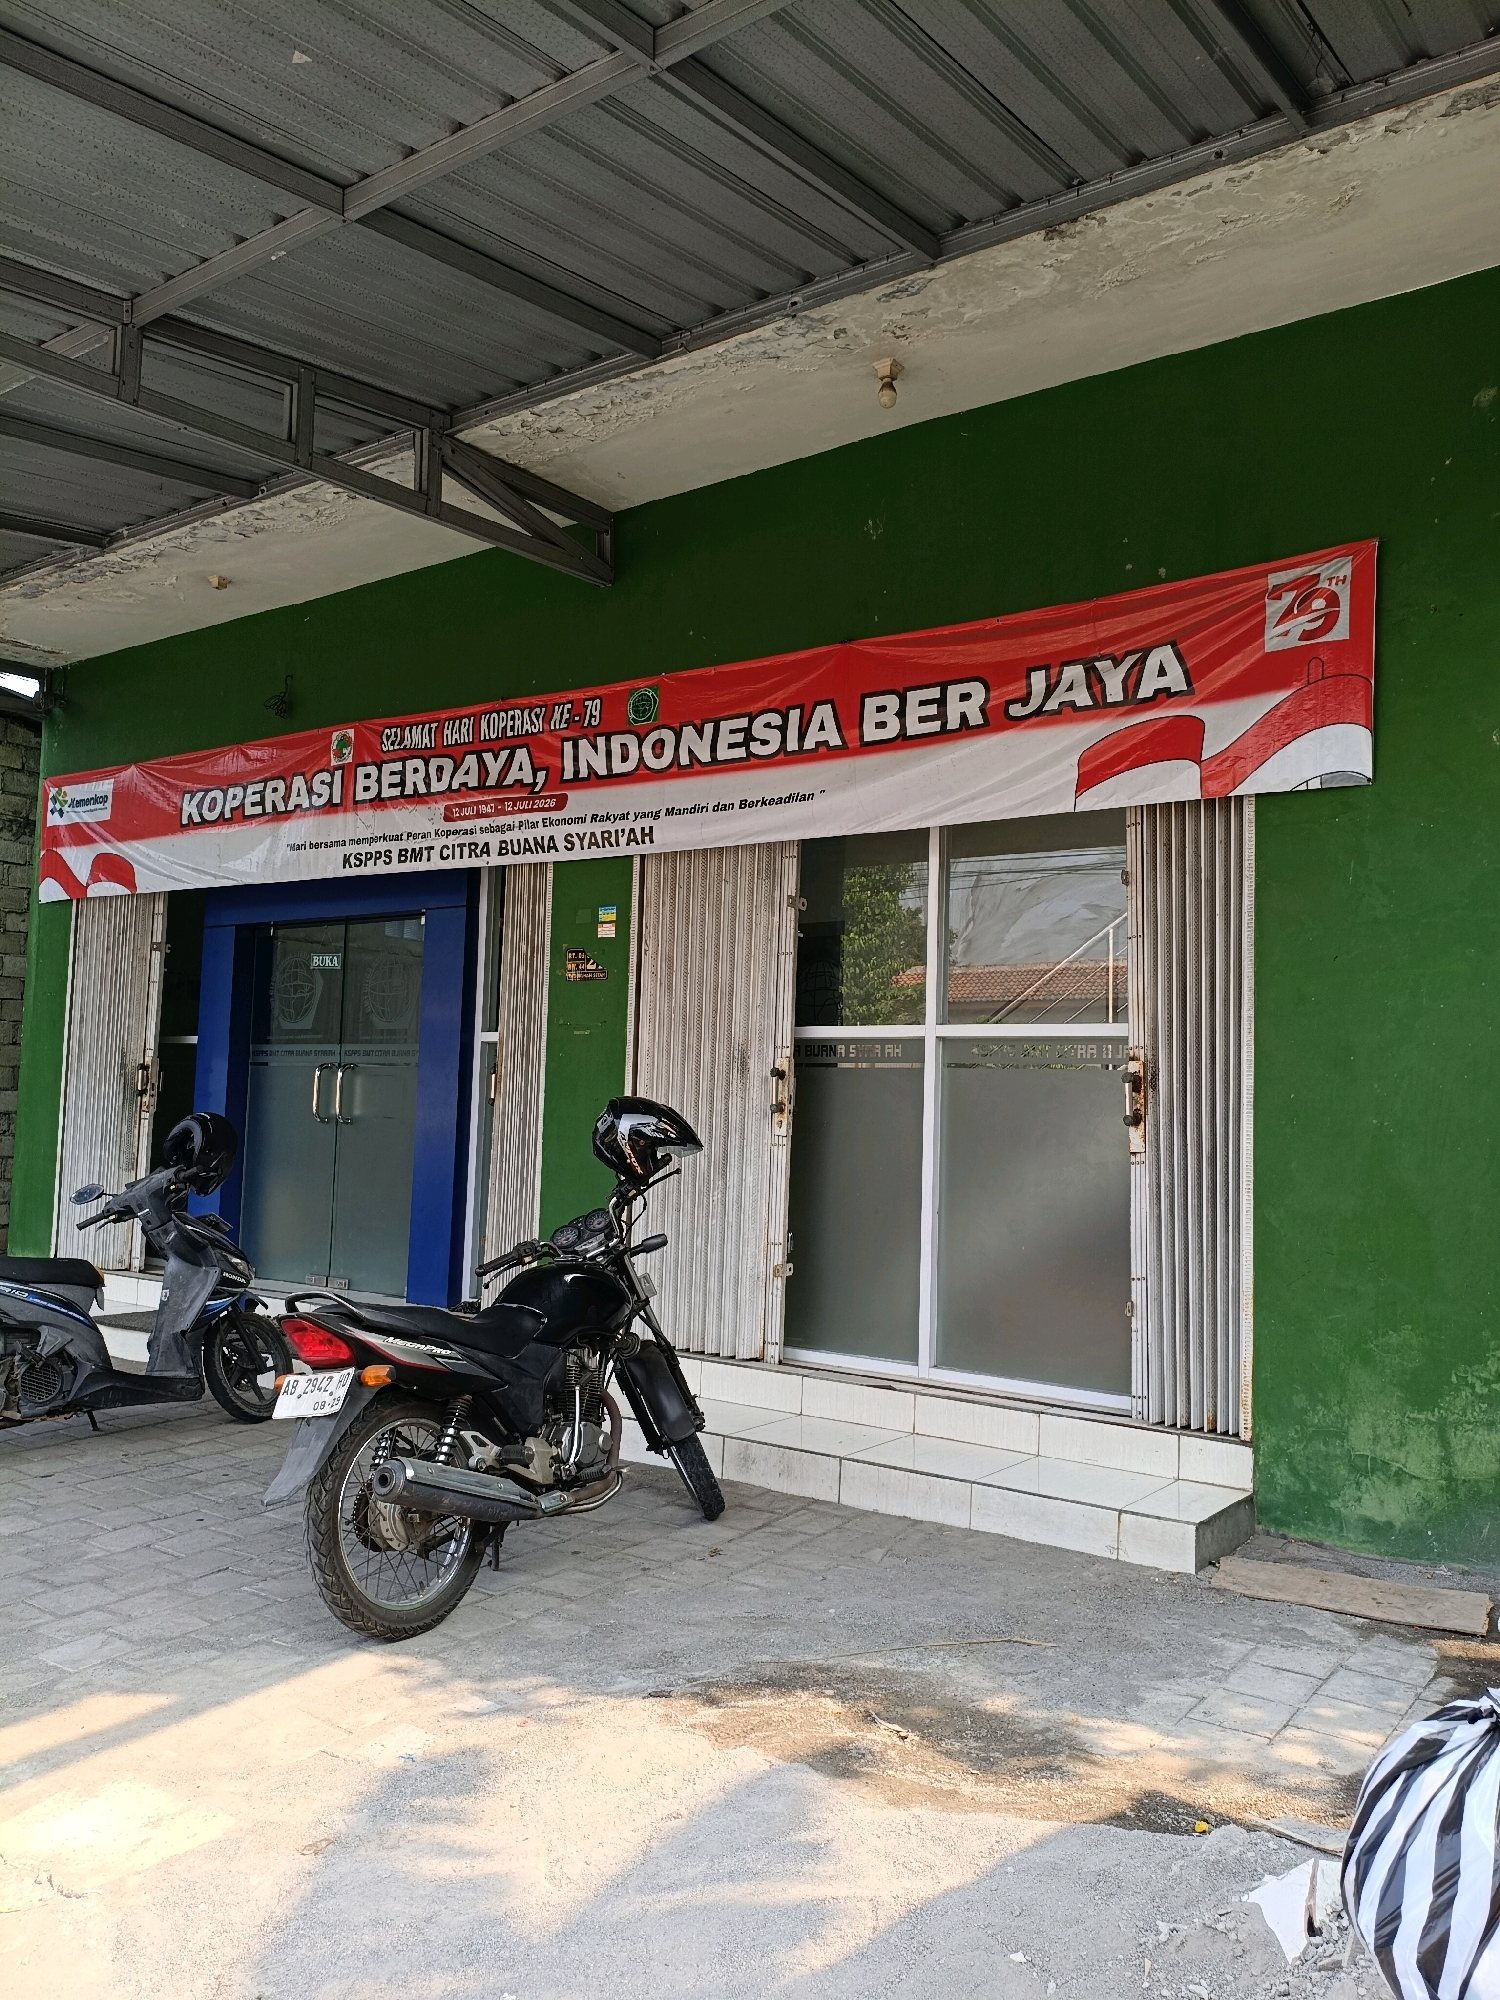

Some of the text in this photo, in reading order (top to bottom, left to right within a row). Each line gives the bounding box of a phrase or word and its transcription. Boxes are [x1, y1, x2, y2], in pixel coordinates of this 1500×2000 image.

[1326, 574, 1347, 587] TH
[180, 768, 344, 826] KOPERASI
[355, 747, 547, 801] BERDAYA,
[561, 702, 844, 781] INDONESIA
[862, 680, 988, 743] BER
[1007, 643, 1189, 718] JAYA
[381, 722, 438, 752] SELAMAT
[443, 717, 474, 746] HARI
[480, 707, 546, 741] KOPERASI
[68, 793, 109, 809] Kemenkop
[452, 808, 460, 818] 12
[460, 806, 477, 817] JULI
[478, 803, 495, 815] 1947
[504, 801, 513, 811] 12
[513, 800, 533, 811] JULI
[533, 798, 557, 809] 2026
[308, 839, 347, 851] bersama
[348, 832, 404, 848] memperkuat
[406, 830, 432, 842] Peran
[434, 825, 478, 840] Koperasi
[479, 821, 516, 836] sebagai
[518, 818, 540, 832] Pilar
[541, 813, 588, 828] Ekonomi
[590, 810, 631, 824] Rakyat
[632, 808, 663, 823] yang
[664, 802, 709, 818] Mandiri
[712, 801, 735, 813] dan
[738, 791, 815, 811] Berkeadilan
[342, 825, 655, 870] KSPPS BMT CITRA BUANA SYARI'AH
[312, 955, 339, 967] BUKA
[804, 1044, 846, 1058] BUANA
[222, 1271, 247, 1284] HONDA
[282, 1379, 299, 1396] AB
[303, 1375, 334, 1395] 2942
